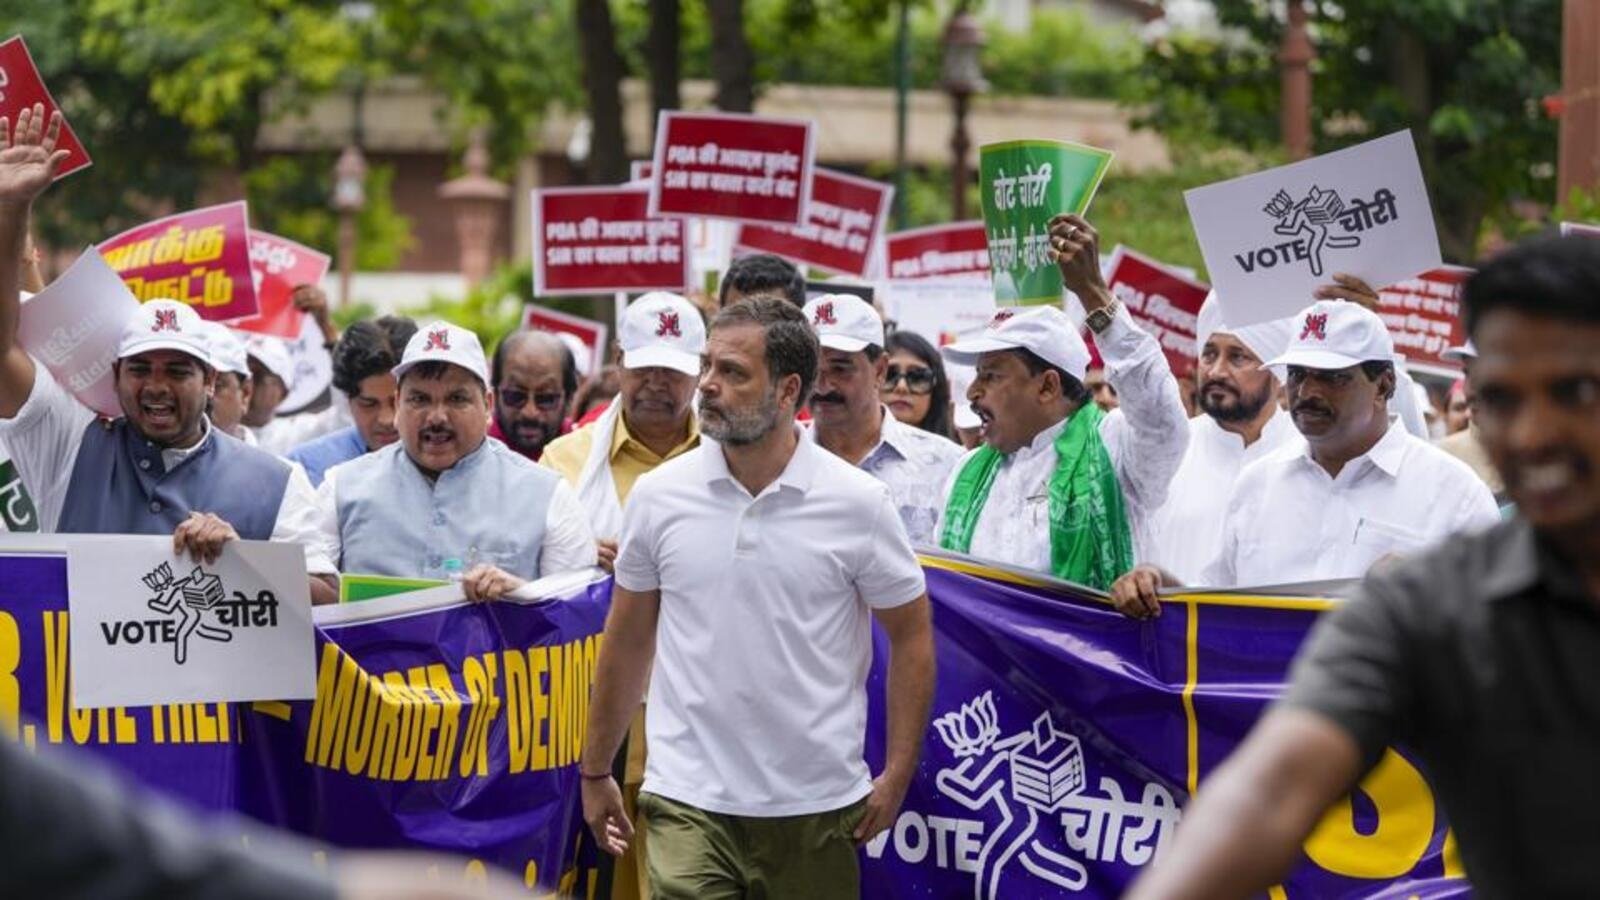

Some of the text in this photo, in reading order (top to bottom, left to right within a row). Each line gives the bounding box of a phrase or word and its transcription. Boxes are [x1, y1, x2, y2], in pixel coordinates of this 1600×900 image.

[993, 162, 1052, 211] वोट चोरी
[1337, 188, 1398, 232] चोरी
[1234, 239, 1309, 273] VOTE
[214, 590, 279, 627] चोरी
[100, 620, 176, 645] VOTE
[304, 632, 605, 781] MURDER OF DEMOC
[1058, 777, 1185, 866] चोरी
